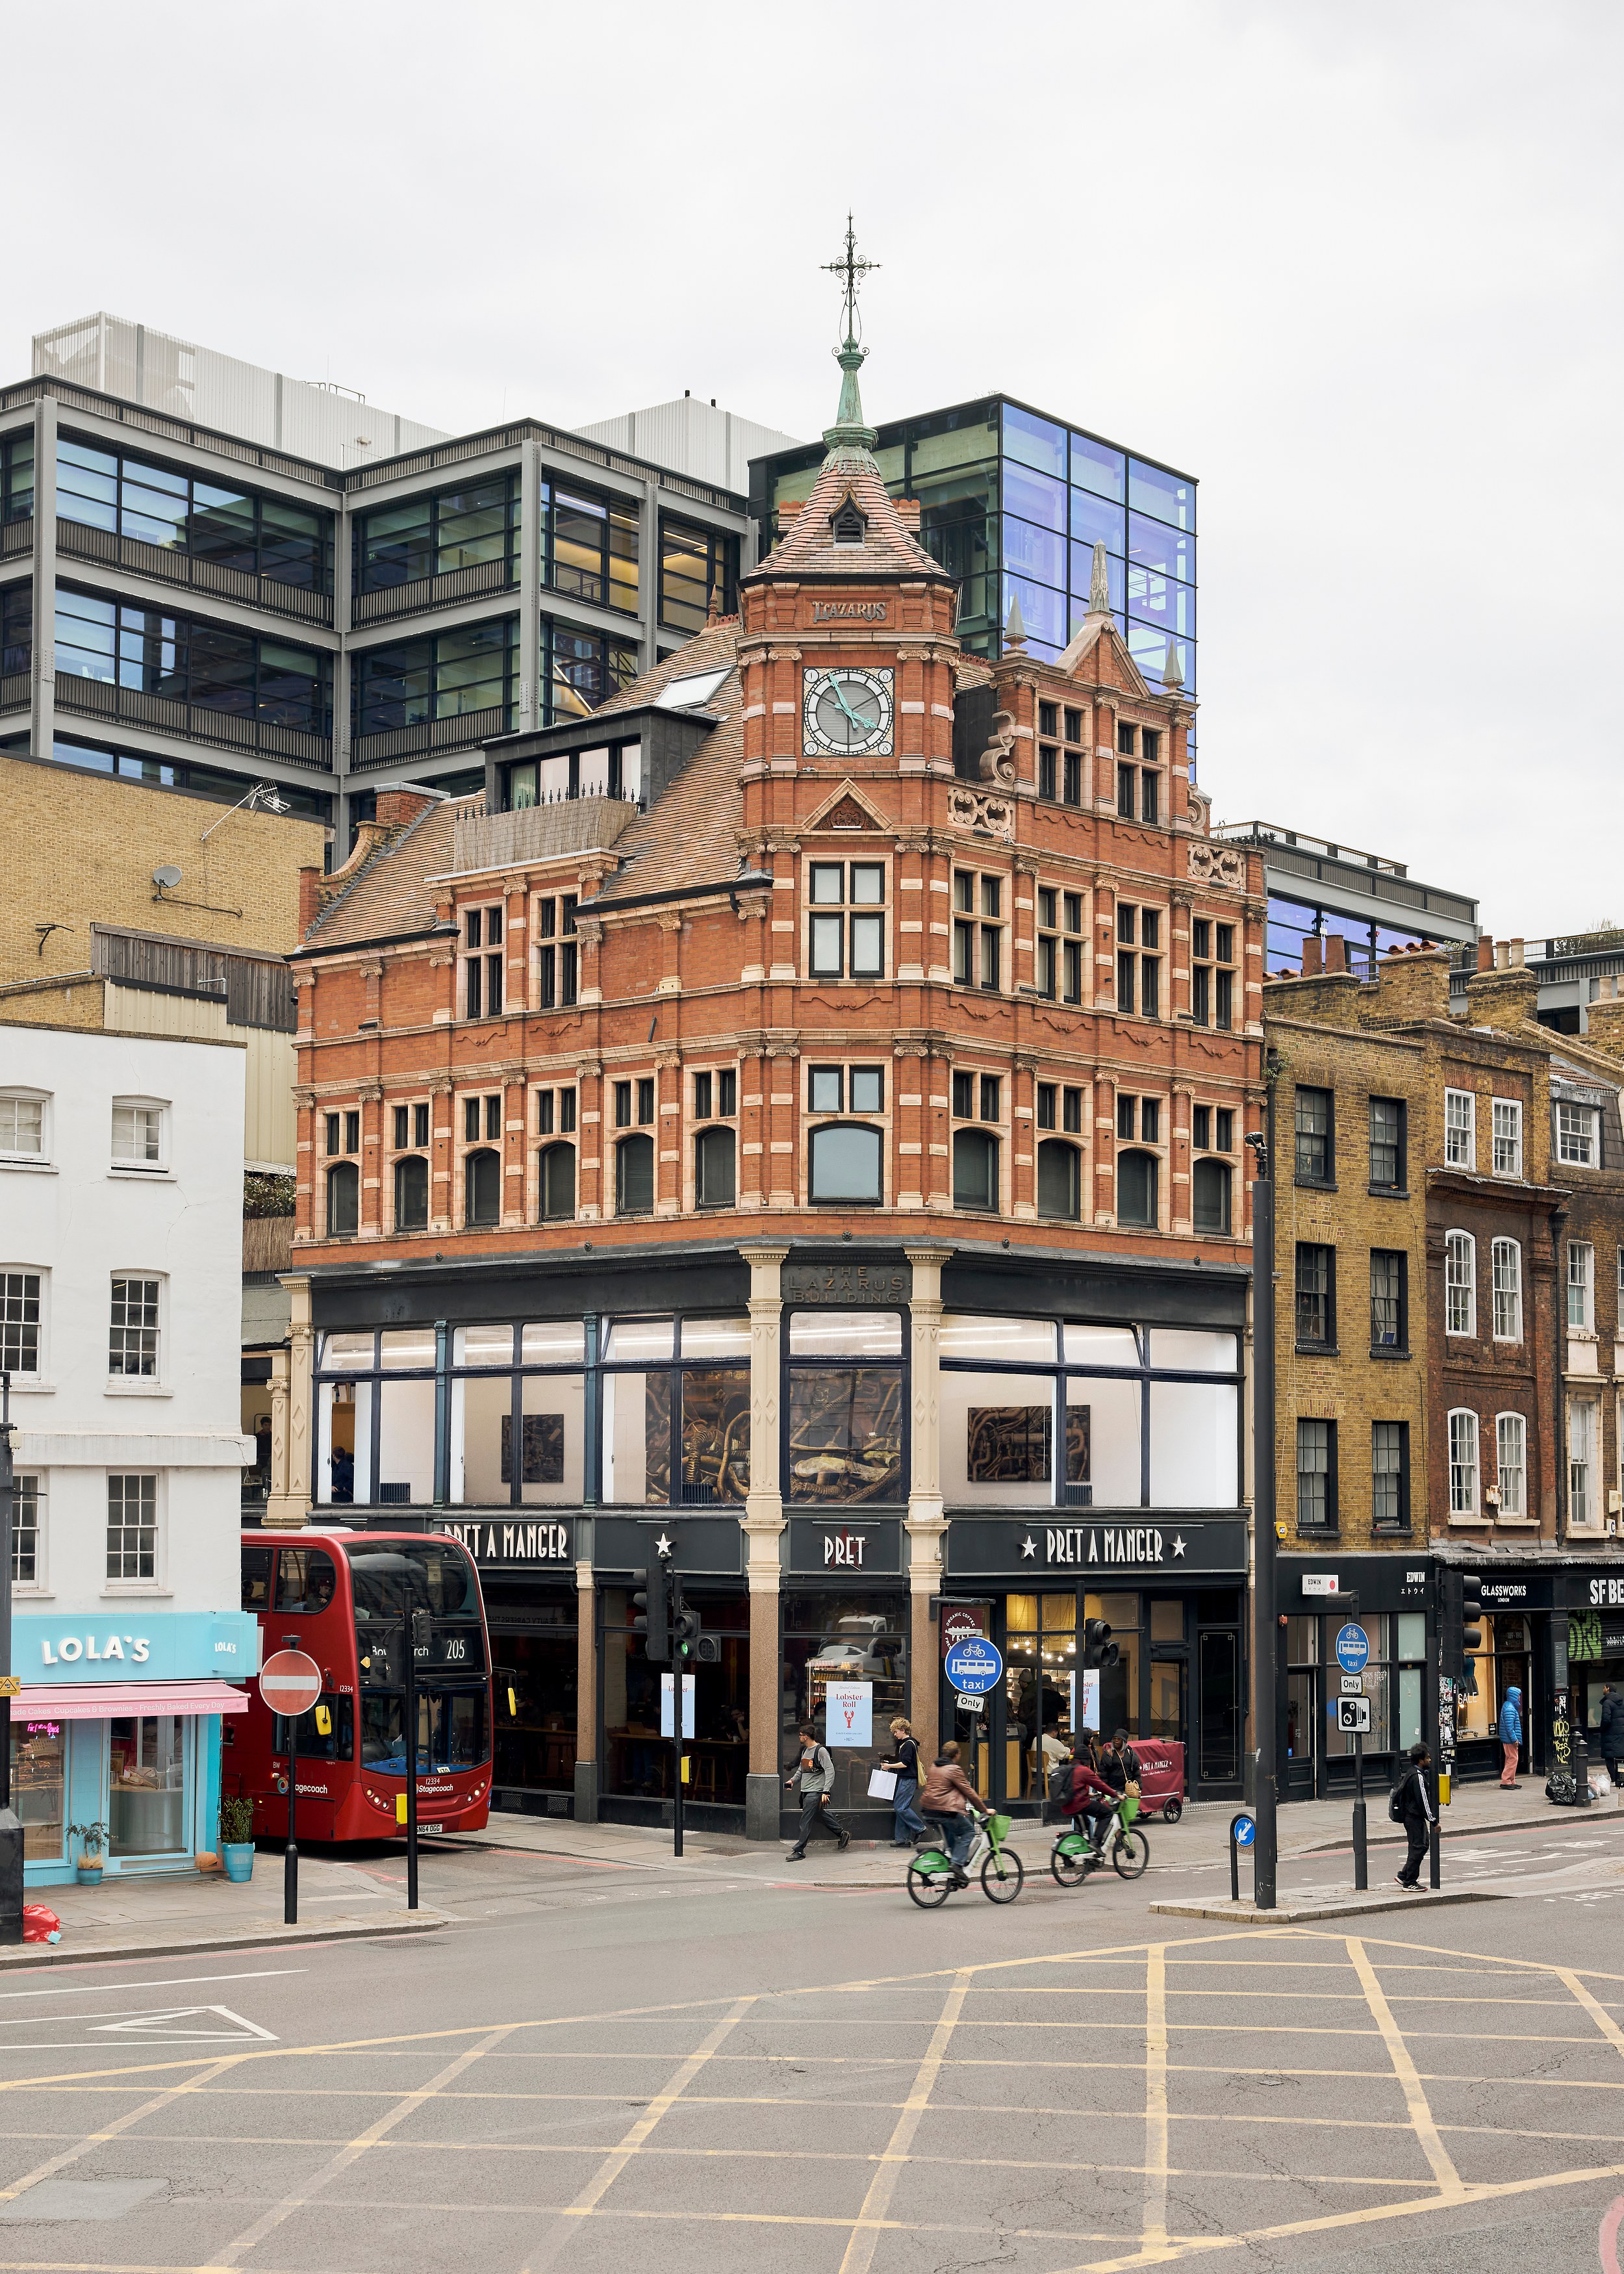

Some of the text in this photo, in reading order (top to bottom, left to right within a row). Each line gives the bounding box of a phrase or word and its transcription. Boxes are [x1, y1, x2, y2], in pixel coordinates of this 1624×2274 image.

[812, 602, 887, 623] LAZARUS
[827, 1267, 867, 1277] THE
[789, 1276, 904, 1290] LAZARUS
[792, 1290, 900, 1303] BUILDING
[487, 1524, 496, 1557] A
[503, 1524, 568, 1558] MANGER
[1047, 1529, 1163, 1563] PRET A MANGER
[824, 1536, 865, 1565] PRET
[1406, 1572, 1425, 1583] EDWIN
[1481, 1585, 1527, 1596] GLASSWORKS
[1590, 1579, 1606, 1604] SF
[946, 1612, 976, 1627] ORGANIC COFFEE
[42, 1636, 150, 1665] LOLA'S
[214, 1642, 236, 1654] LOLA'S
[372, 1646, 387, 1655] Bo
[446, 1639, 465, 1659] 205
[963, 1679, 984, 1689] taxi
[1343, 1680, 1359, 1689] Only
[961, 1697, 980, 1709] Only
[1458, 1691, 1477, 1704] SALE
[55, 1706, 90, 1715] Cupcakes
[99, 1704, 133, 1713] Brownies
[1154, 1760, 1169, 1769] MANGER
[295, 1784, 327, 1794] agecoach
[418, 1784, 453, 1794] Stagecoach
